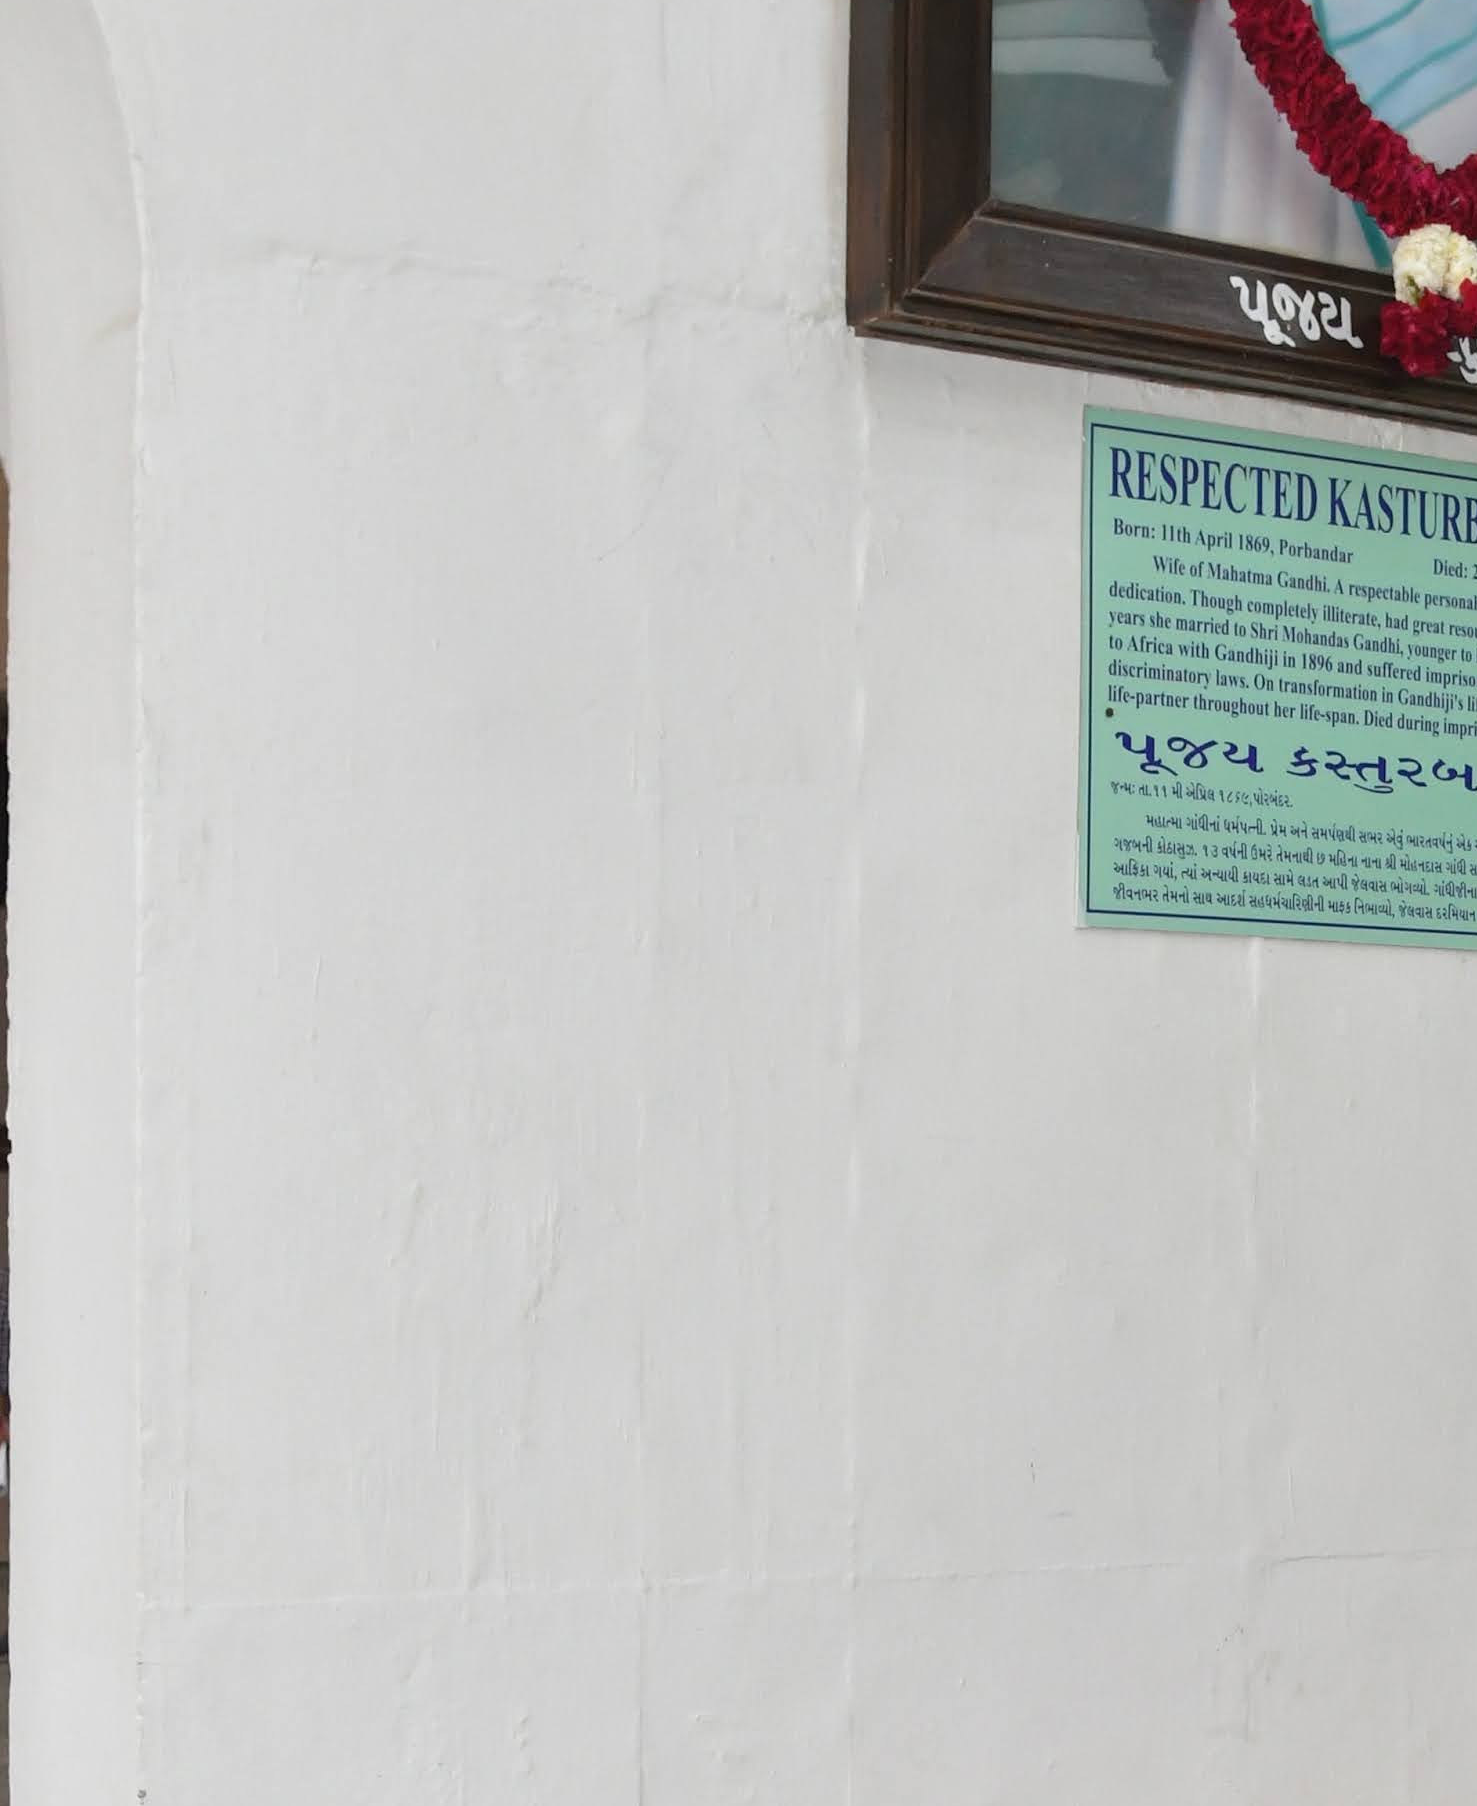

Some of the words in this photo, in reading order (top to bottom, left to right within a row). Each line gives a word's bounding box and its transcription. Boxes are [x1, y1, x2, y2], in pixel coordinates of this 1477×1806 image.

[1107, 445, 1318, 522] RESPECTED
[1113, 516, 1155, 539] Born:
[1160, 523, 1191, 544] 11th
[1194, 528, 1233, 552] April
[1238, 532, 1274, 556] 1869,
[1278, 538, 1354, 563] Porbandar
[1152, 554, 1186, 576] Wife
[1188, 560, 1205, 578] of
[1206, 561, 1273, 586] Mahatma
[1276, 570, 1331, 593] Gandhi.
[1332, 577, 1344, 595] A
[1348, 583, 1420, 604] respectable
[1432, 557, 1468, 579] Died:
[1108, 579, 1186, 605] dedication.
[1189, 588, 1243, 616] Though
[1246, 599, 1318, 625] completely
[1322, 603, 1381, 631] illiterate,
[1384, 610, 1409, 631] had
[1411, 619, 1445, 637] great
[1107, 610, 1145, 628] years
[1148, 609, 1172, 630] she
[1175, 615, 1229, 636] married
[1233, 621, 1246, 638] to
[1249, 620, 1278, 641] Shri
[1280, 624, 1349, 649] Mohandas
[1352, 632, 1404, 658] Gandhi,
[1406, 643, 1457, 664] younger
[1460, 647, 1472, 663] to
[1108, 633, 1123, 651] to
[1126, 634, 1173, 656] Africa
[1176, 639, 1210, 660] with
[1213, 642, 1278, 671] Gandhiji
[1282, 649, 1296, 668] in
[1301, 652, 1333, 673] 1896
[1336, 658, 1362, 676] and
[1366, 660, 1421, 682] suffered
[1107, 657, 1212, 690] discriminatory
[1215, 668, 1249, 689] laws.
[1252, 672, 1274, 692] On
[1278, 676, 1378, 702] transformation
[1381, 685, 1393, 704] in
[1396, 687, 1464, 714] Gandhiji's
[1107, 683, 1190, 709] life-partner
[1192, 692, 1270, 718] throughout
[1273, 699, 1296, 719] her
[1299, 702, 1360, 728] life-span.
[1362, 708, 1393, 728] Died
[1396, 712, 1440, 737] during
[1445, 857, 1467, 875] ગાંધી
